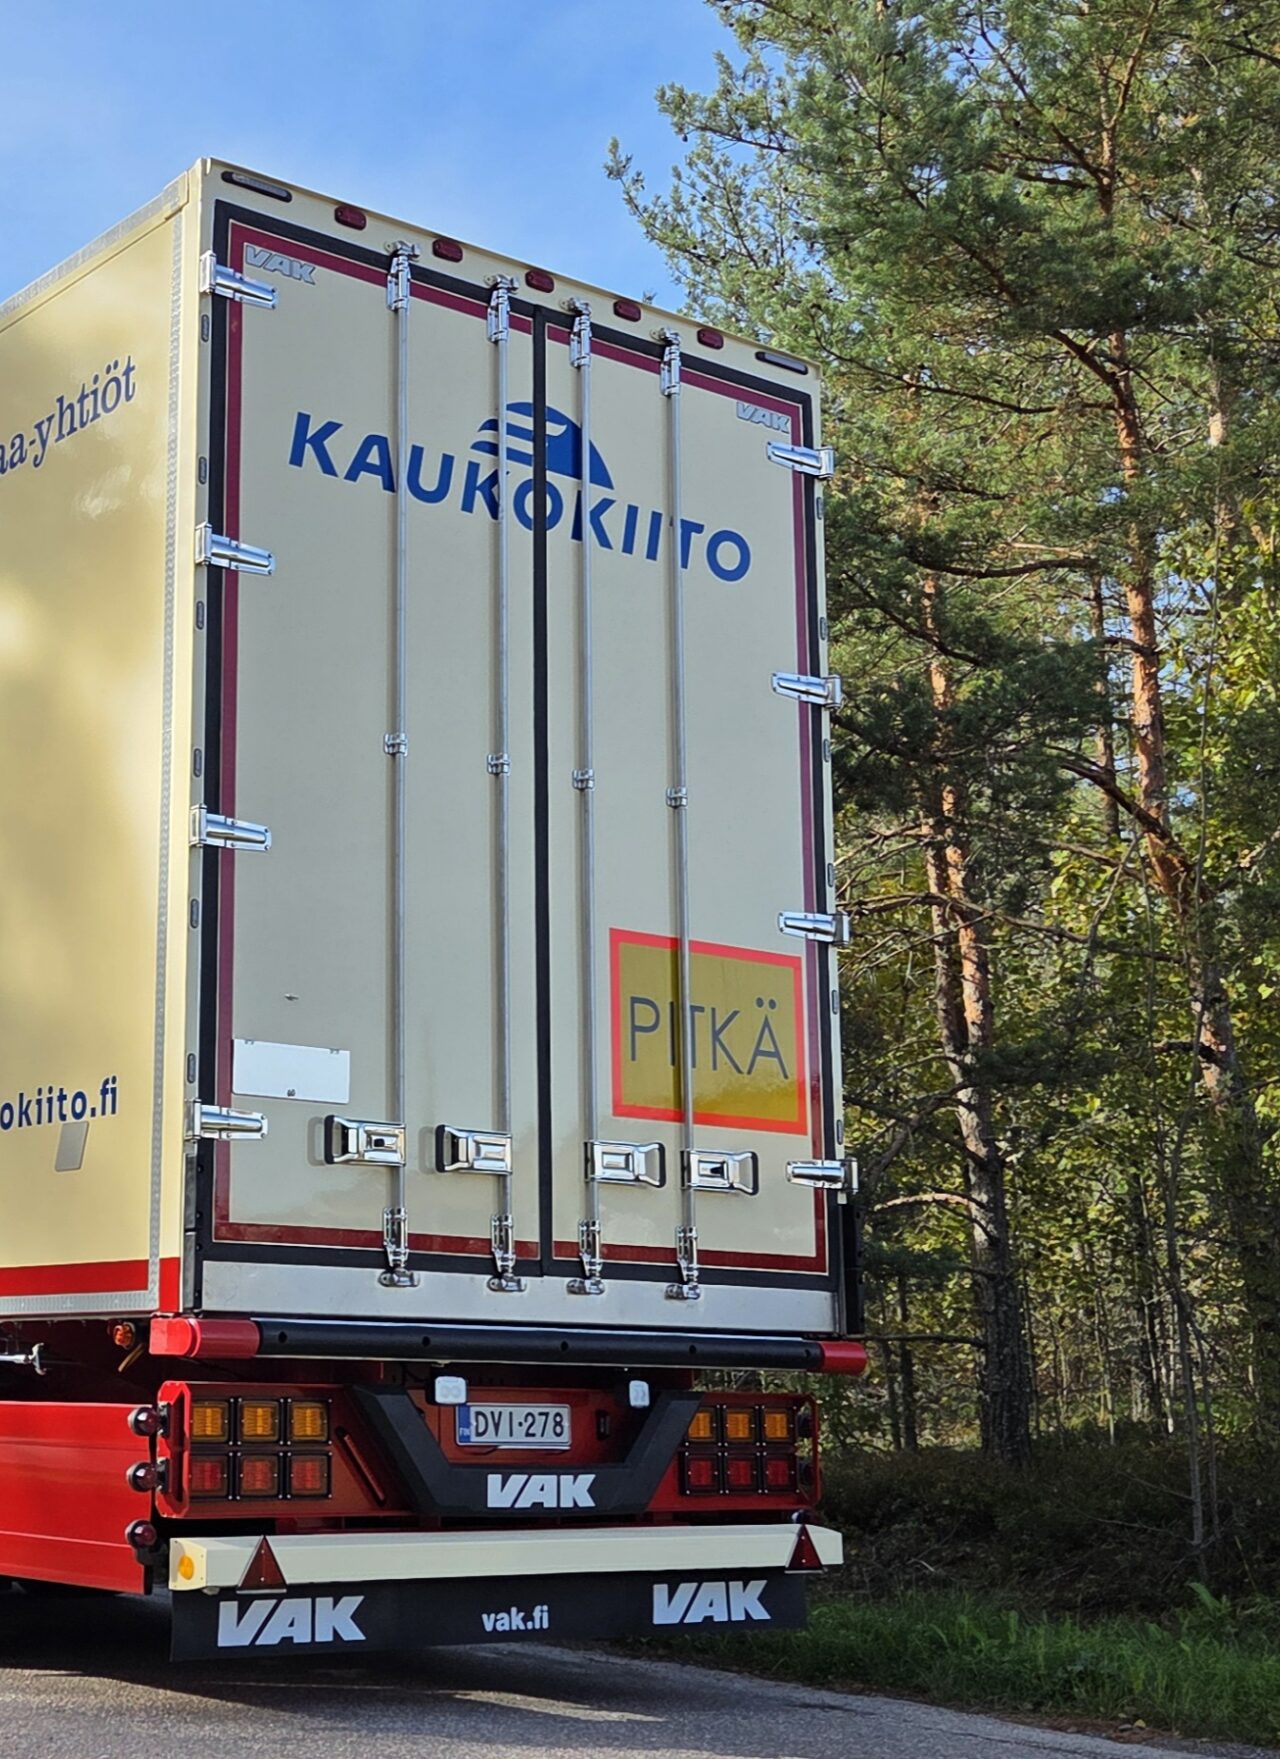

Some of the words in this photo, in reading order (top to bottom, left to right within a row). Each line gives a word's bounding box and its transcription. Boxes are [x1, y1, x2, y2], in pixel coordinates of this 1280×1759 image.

[245, 244, 316, 285] VAK
[736, 401, 790, 434] VAK
[289, 411, 751, 582] KAUKOKIITO
[630, 996, 788, 1079] PITKÄ
[487, 1474, 596, 1508] VAK
[217, 1595, 367, 1647] VAK
[481, 1606, 550, 1633] vak.fi
[652, 1579, 772, 1625] VAK
